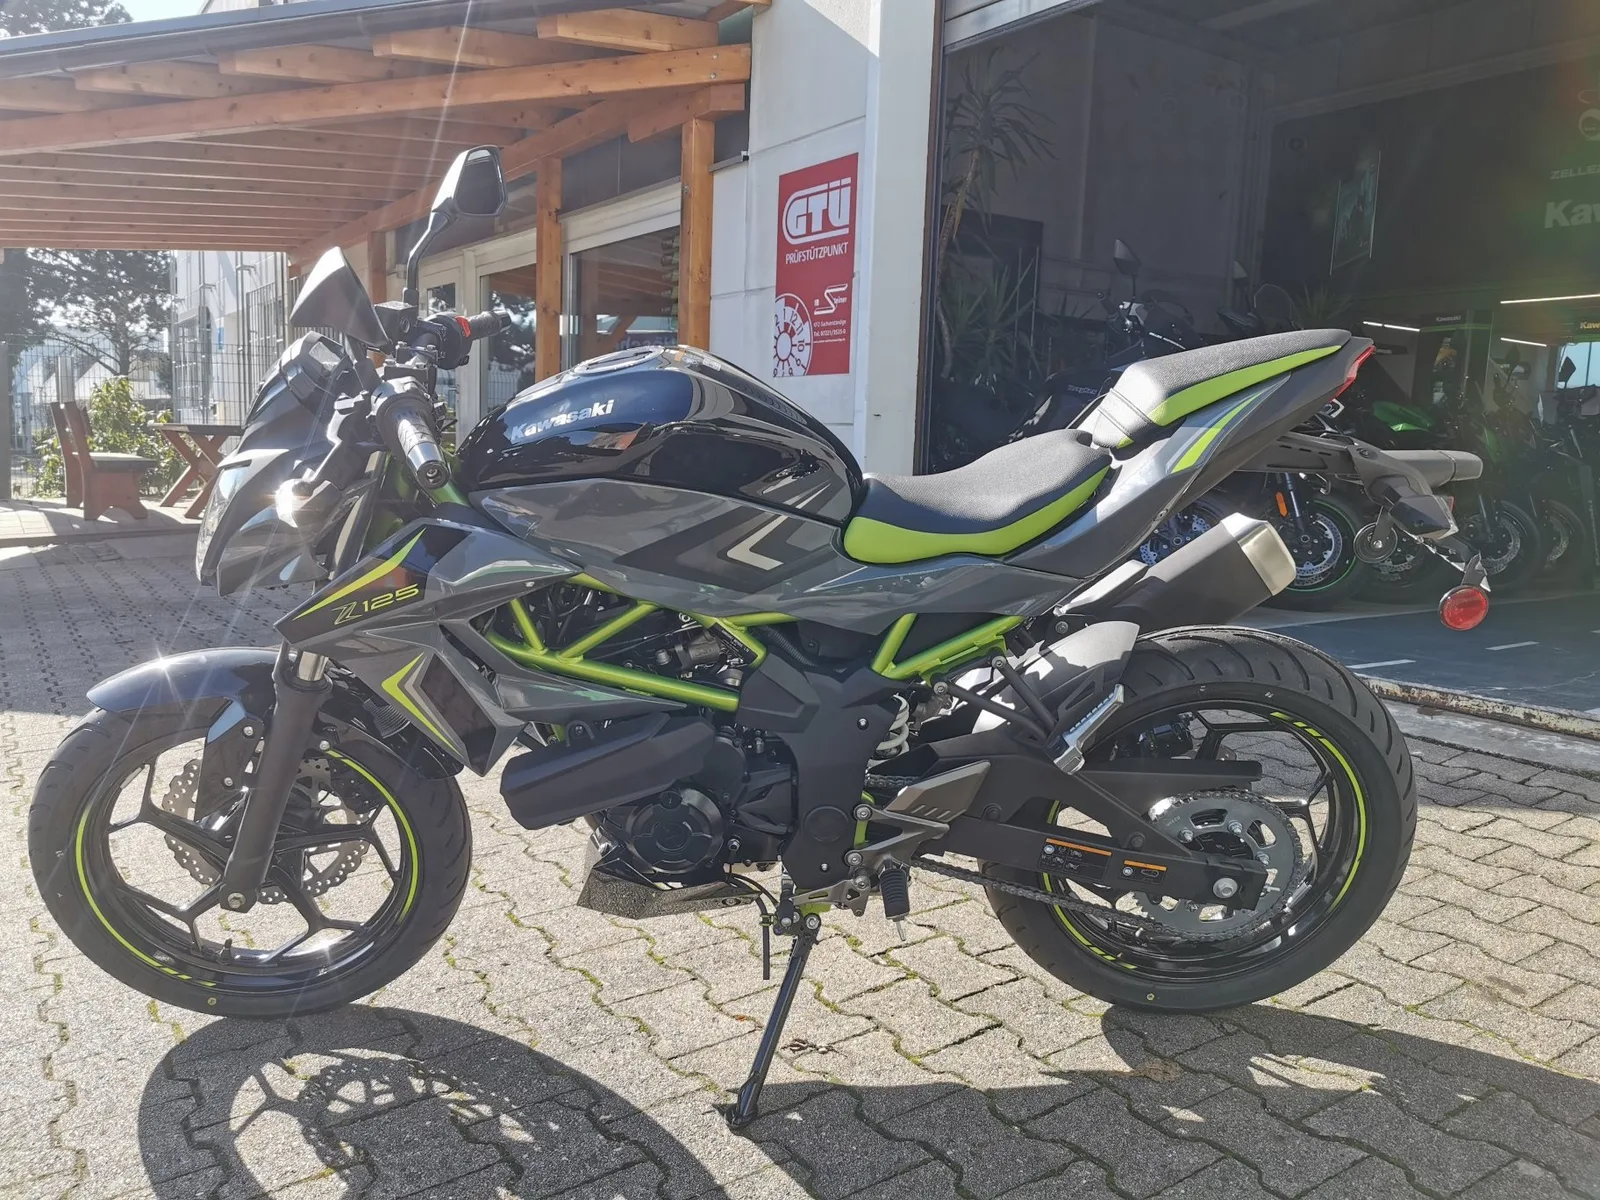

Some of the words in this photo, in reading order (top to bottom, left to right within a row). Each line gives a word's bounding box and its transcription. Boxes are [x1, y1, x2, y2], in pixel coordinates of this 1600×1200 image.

[785, 177, 851, 237] GTÜ
[1545, 199, 1600, 229] Ka
[785, 242, 849, 265] PRÜFSTÜTZPUNKT
[511, 399, 615, 441] Kawasaki
